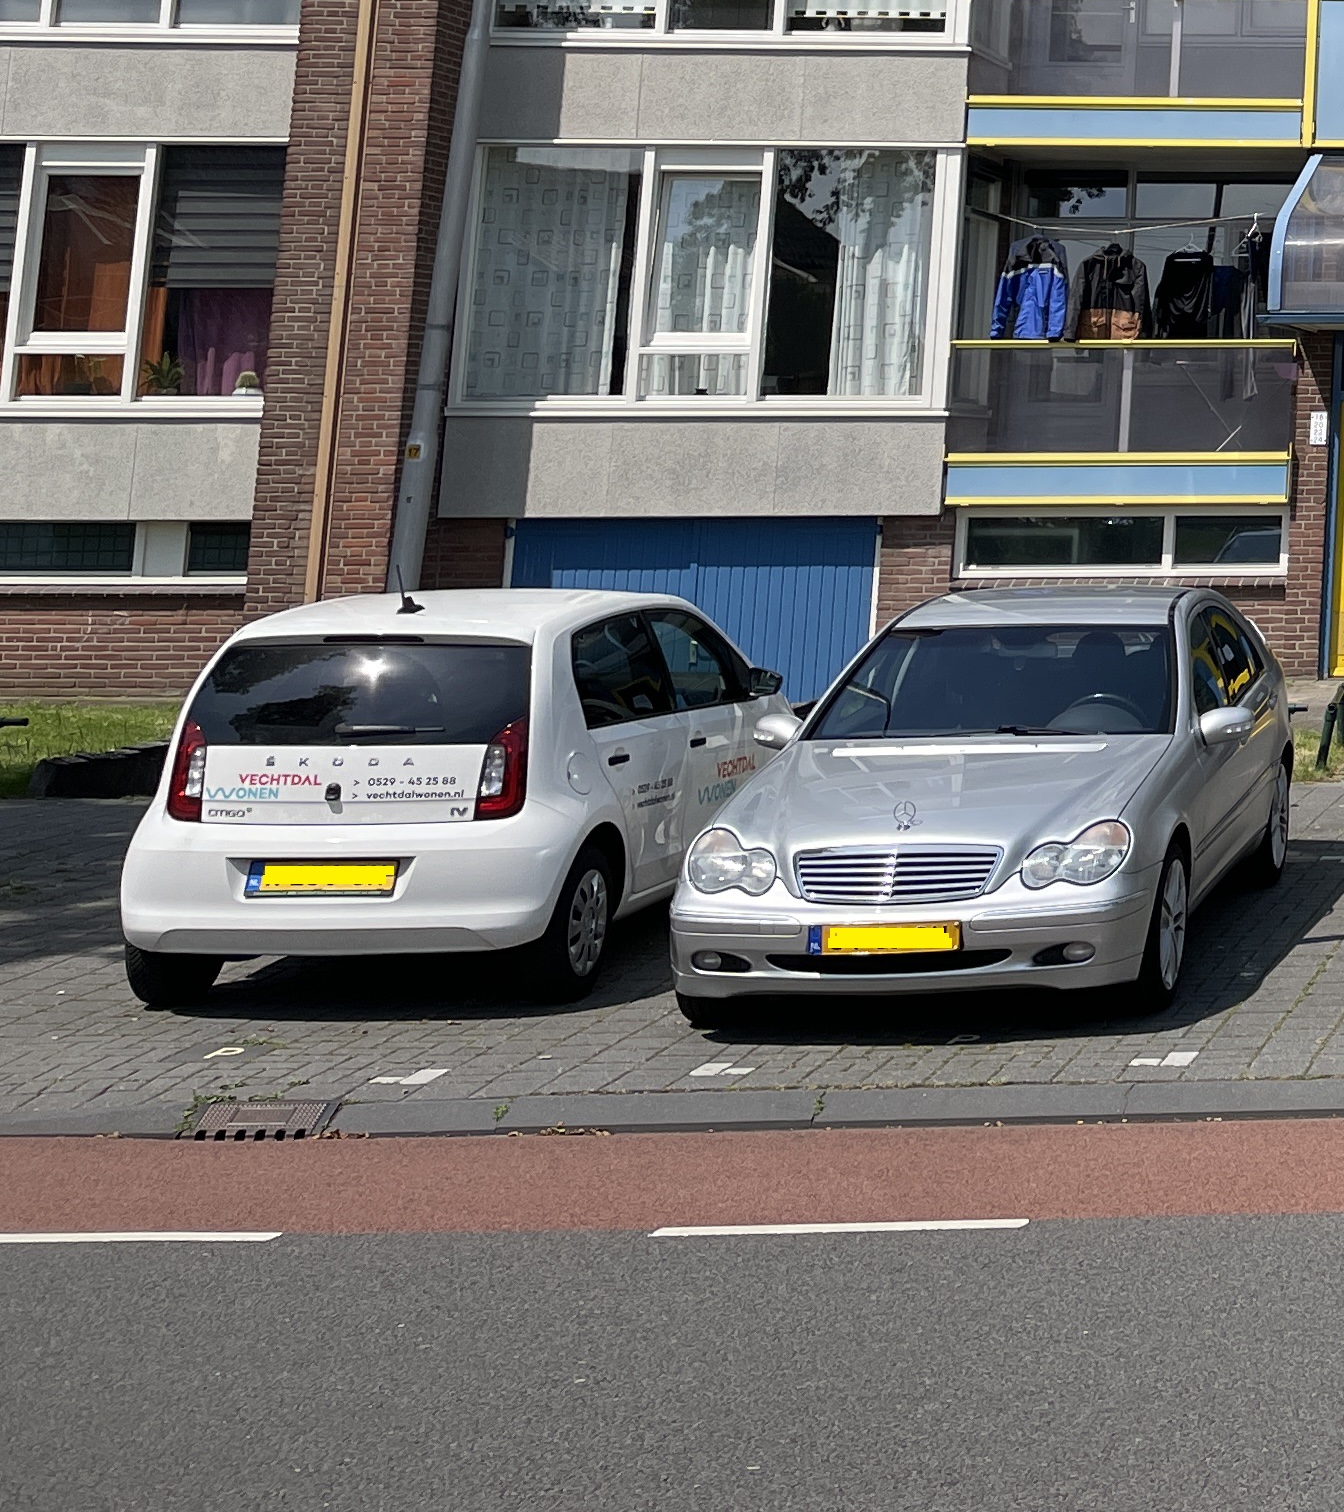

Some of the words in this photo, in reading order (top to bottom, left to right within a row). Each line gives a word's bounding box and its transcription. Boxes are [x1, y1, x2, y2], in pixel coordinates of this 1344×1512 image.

[238, 773, 322, 786] VECHTDAL
[367, 777, 397, 787] 0529
[407, 777, 423, 786] 45
[425, 776, 439, 786] 25
[441, 776, 457, 785] 88
[205, 787, 280, 800] WONEN
[366, 789, 465, 800] vechtdalwonen.nl
[945, 1034, 981, 1045] P
[202, 1047, 245, 1060] P
